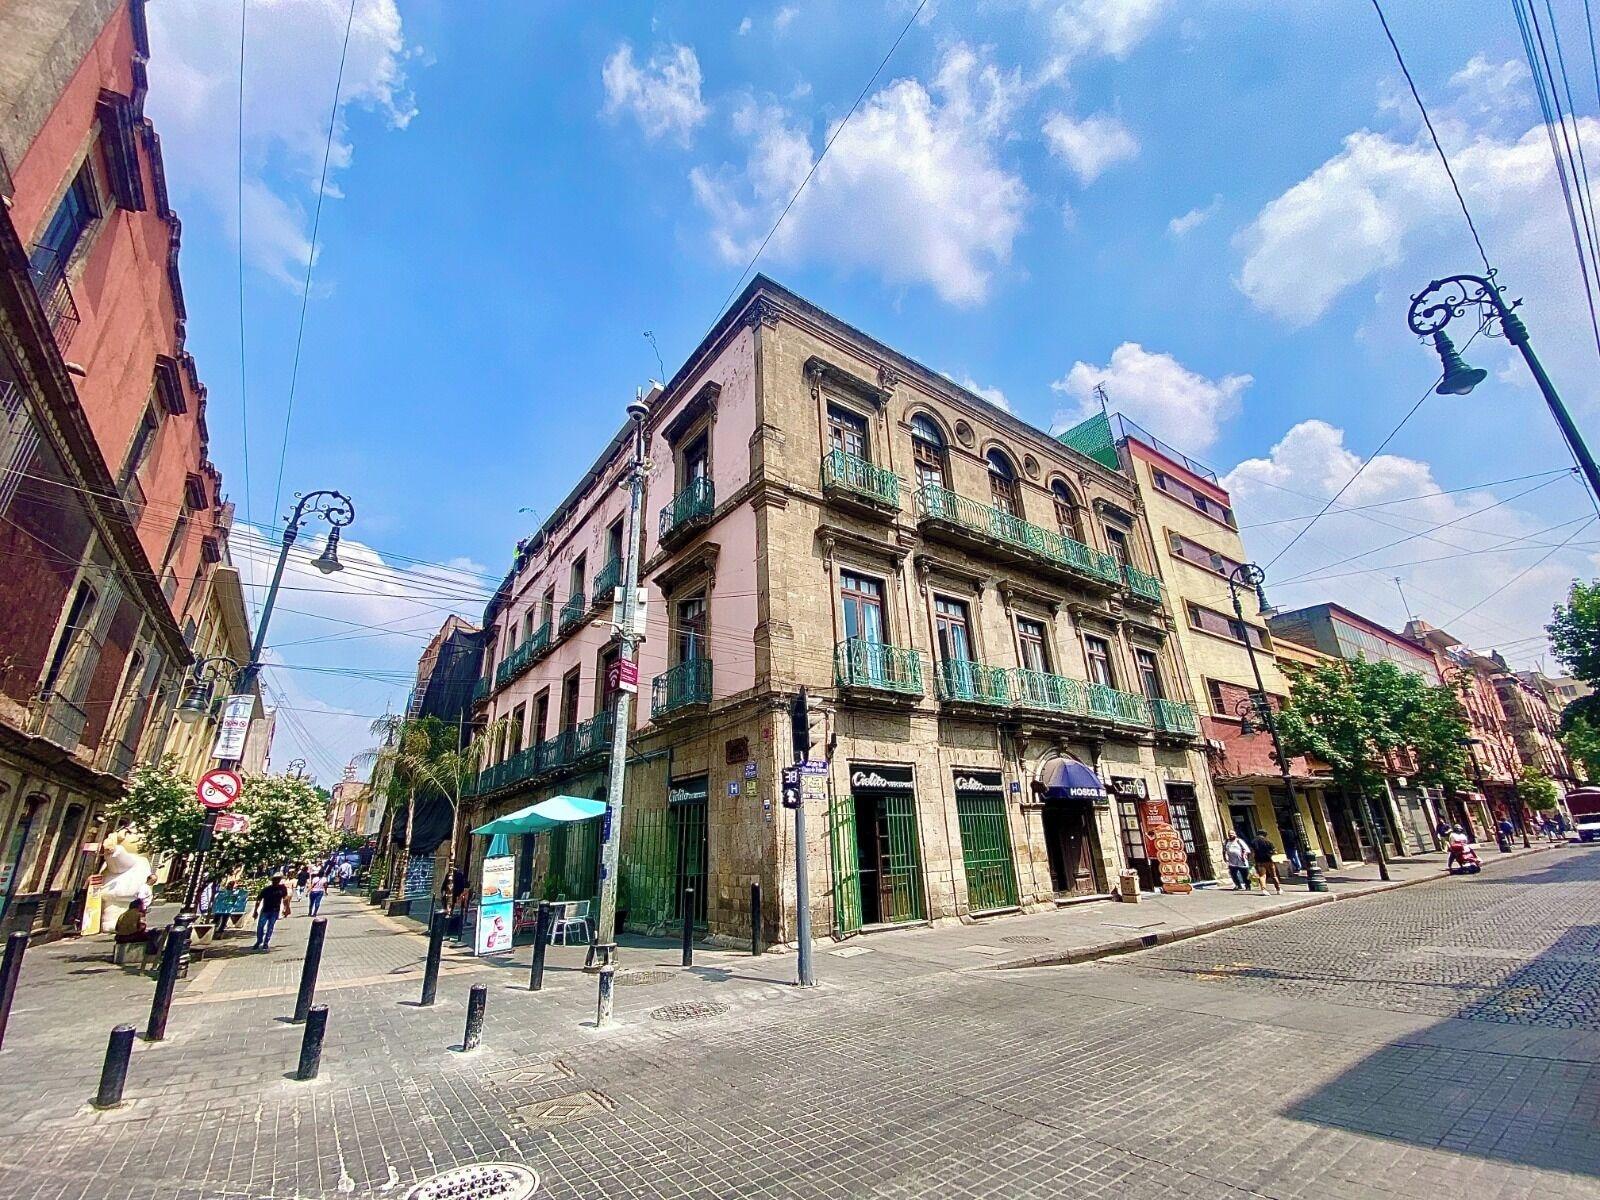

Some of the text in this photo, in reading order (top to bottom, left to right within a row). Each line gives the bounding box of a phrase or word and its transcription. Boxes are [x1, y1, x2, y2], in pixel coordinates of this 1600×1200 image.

[785, 771, 797, 783] 38
[852, 771, 887, 788] Cielito
[730, 784, 738, 794] H
